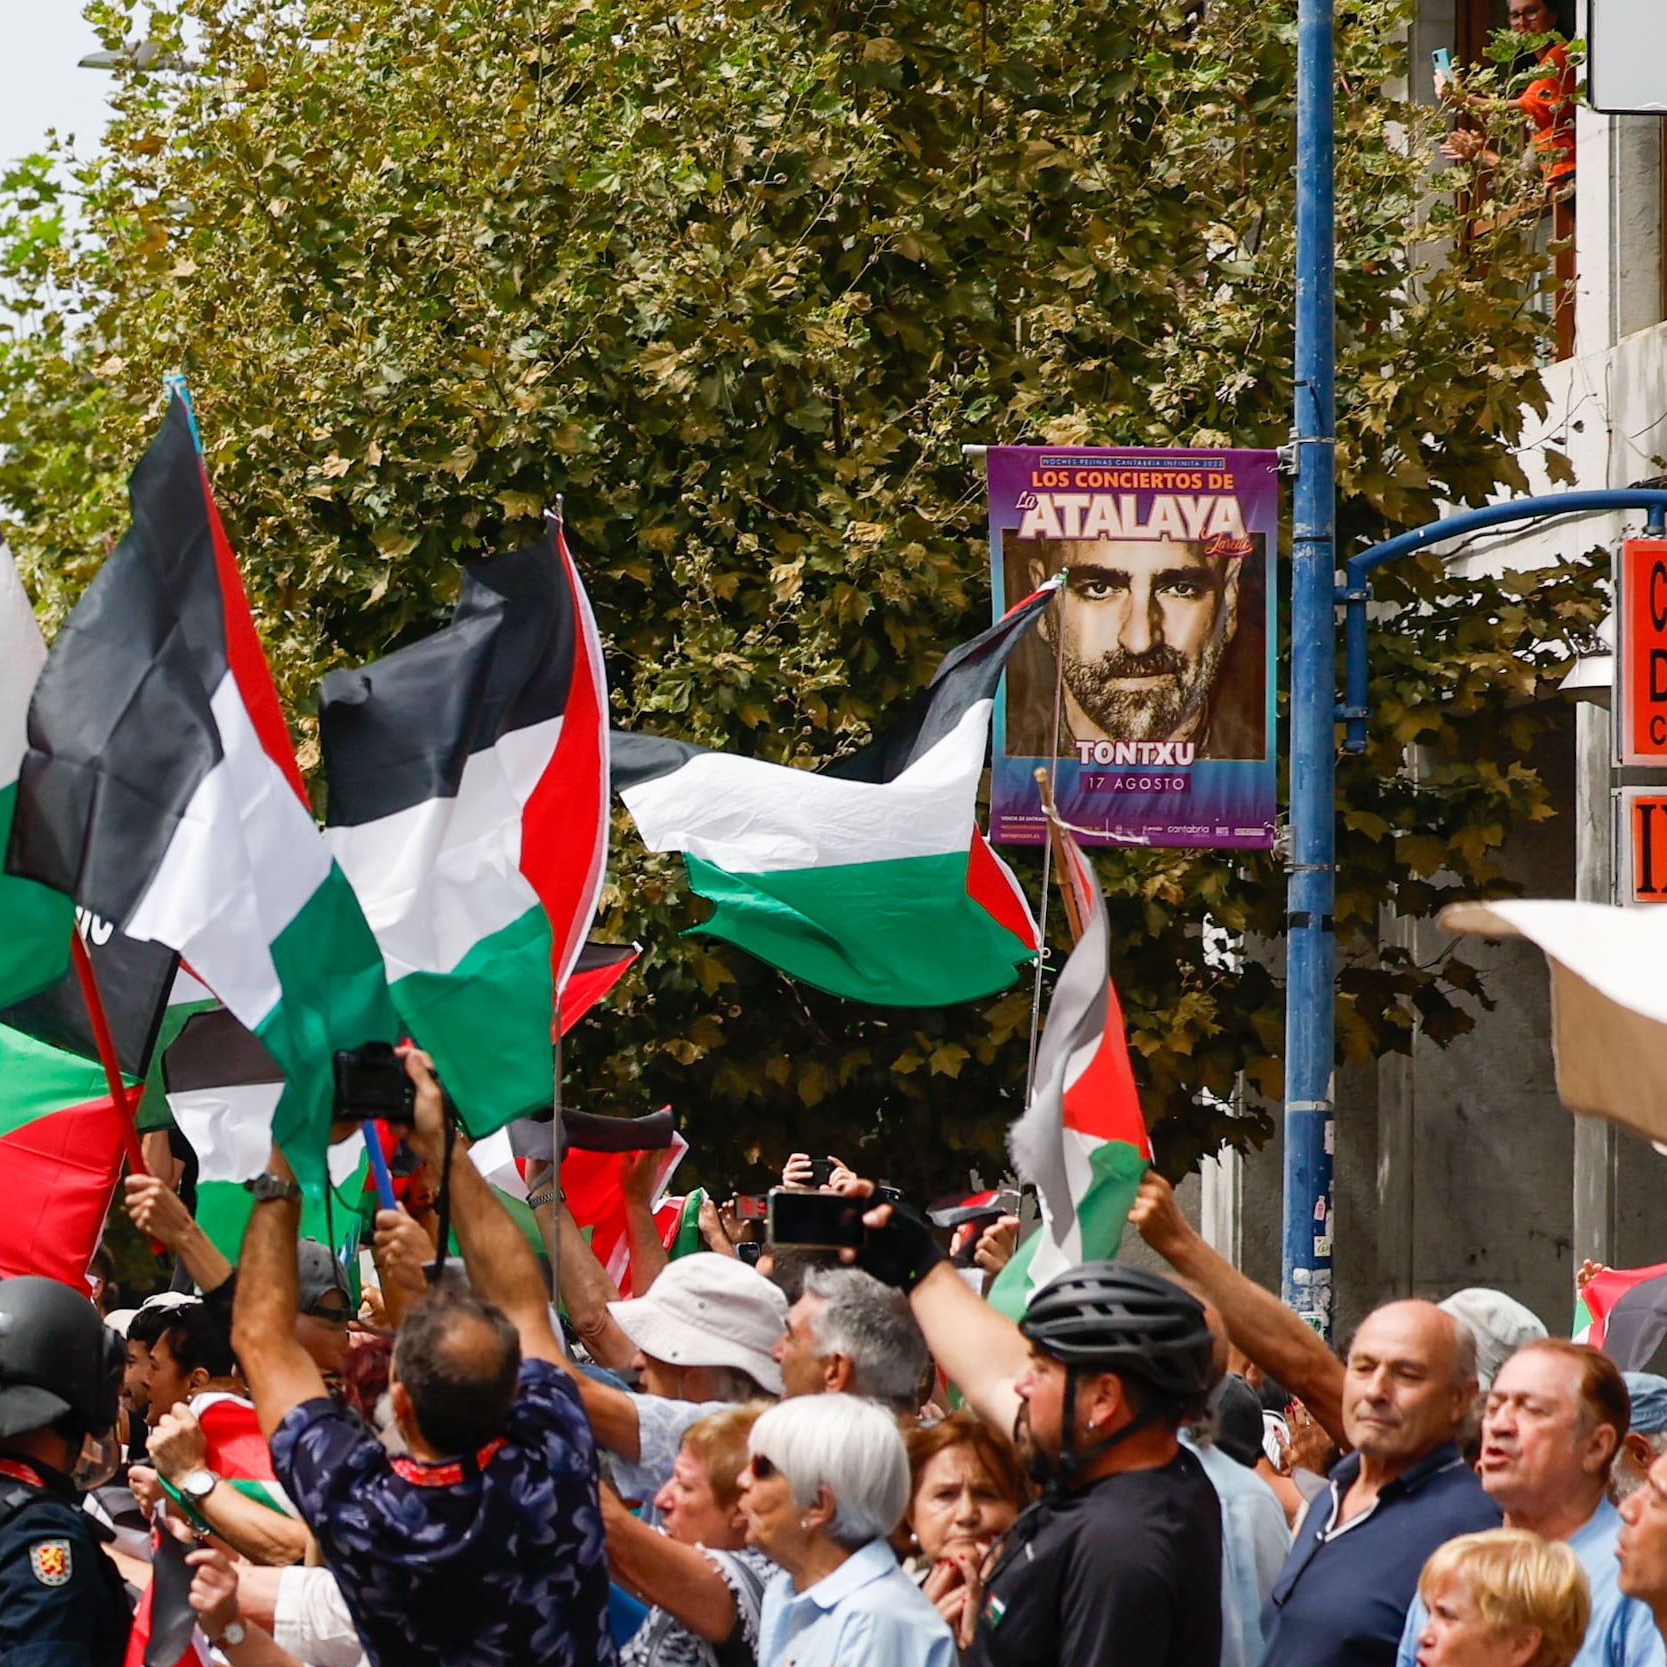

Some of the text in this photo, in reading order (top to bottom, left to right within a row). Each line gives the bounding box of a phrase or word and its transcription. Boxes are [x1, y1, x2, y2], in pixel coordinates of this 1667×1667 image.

[1032, 471, 1235, 489] LOS CONCIERTOS DE
[1019, 493, 1248, 541] ATALAYA
[1076, 741, 1195, 766] TONTXU
[1088, 777, 1185, 791] 17 AGOSTO
[1167, 824, 1210, 835] cantabria
